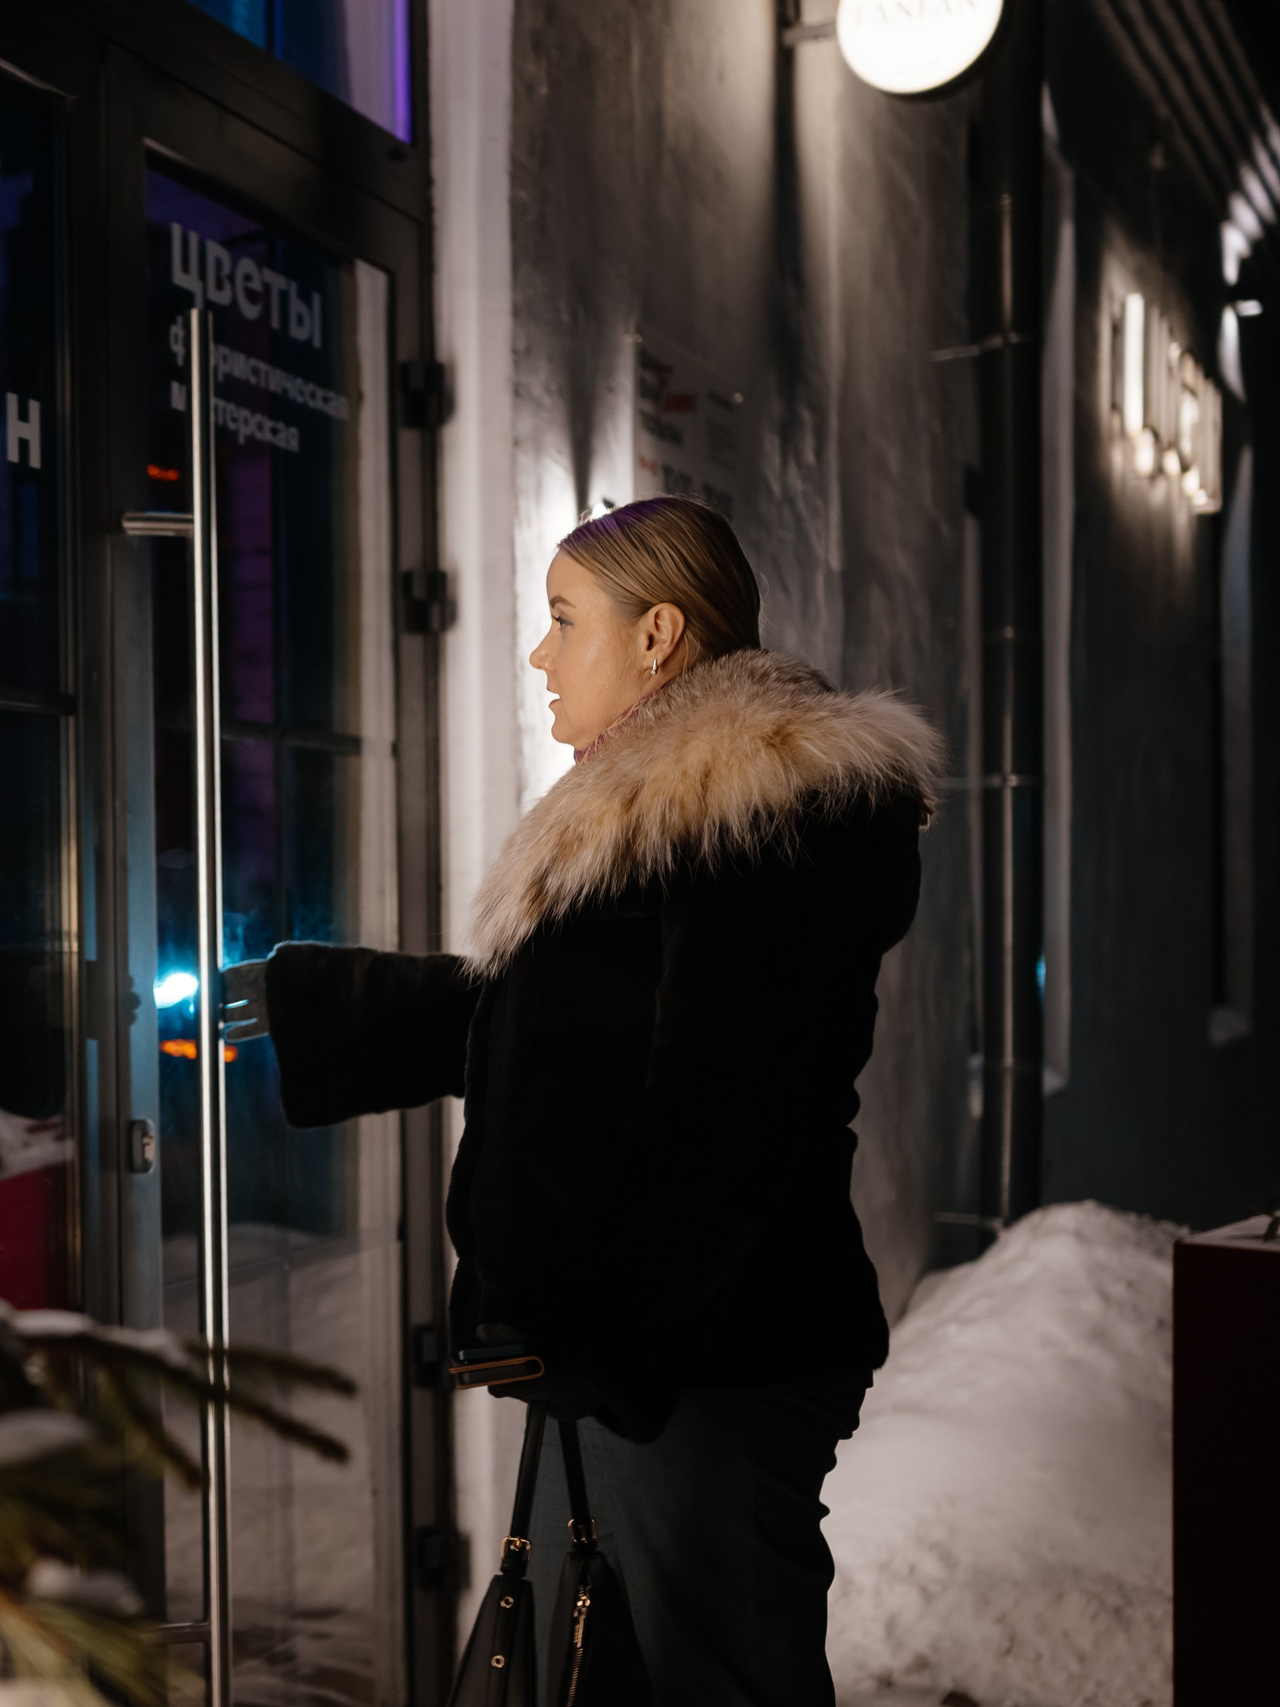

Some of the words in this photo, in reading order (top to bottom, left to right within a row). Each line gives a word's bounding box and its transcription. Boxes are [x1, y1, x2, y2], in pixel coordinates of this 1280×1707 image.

[171, 222, 321, 348] цветы
[169, 315, 350, 422] фристическая
[171, 381, 300, 452] мтерская
